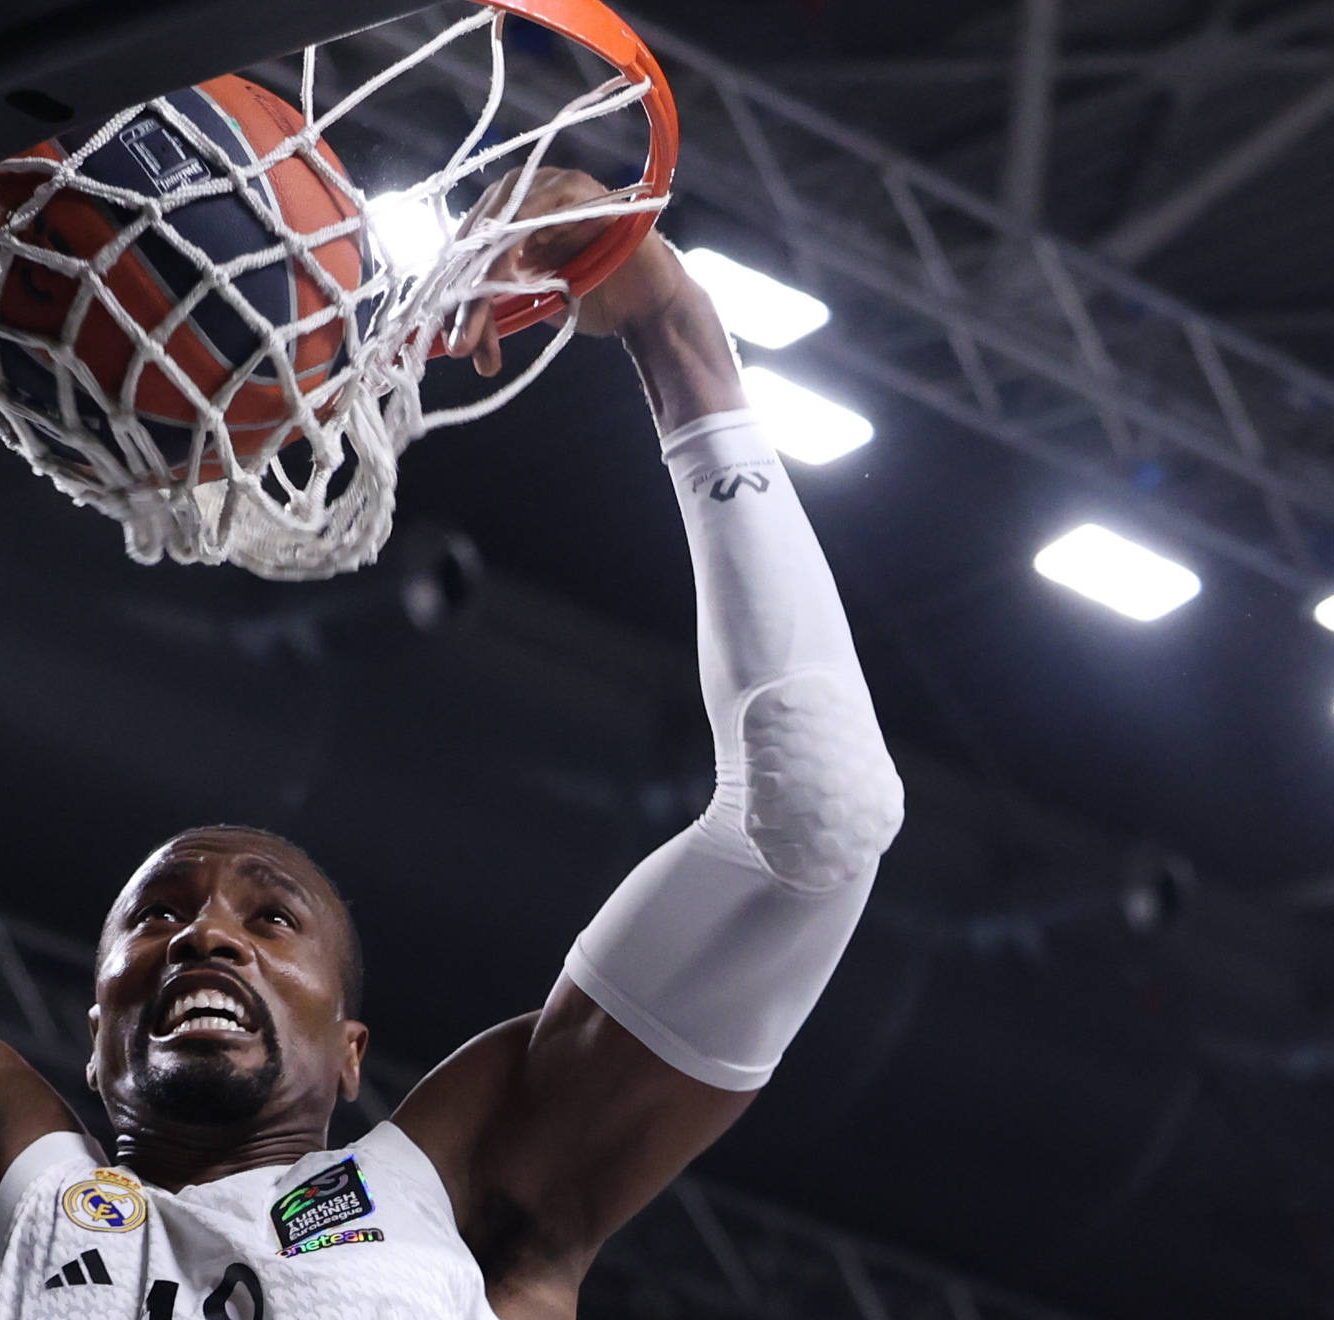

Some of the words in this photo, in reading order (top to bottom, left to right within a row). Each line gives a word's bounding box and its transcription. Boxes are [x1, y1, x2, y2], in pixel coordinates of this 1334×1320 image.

[286, 1191, 357, 1229] TURKISH
[288, 1199, 360, 1235] AIRLINES
[276, 1228, 385, 1258] oneteam
